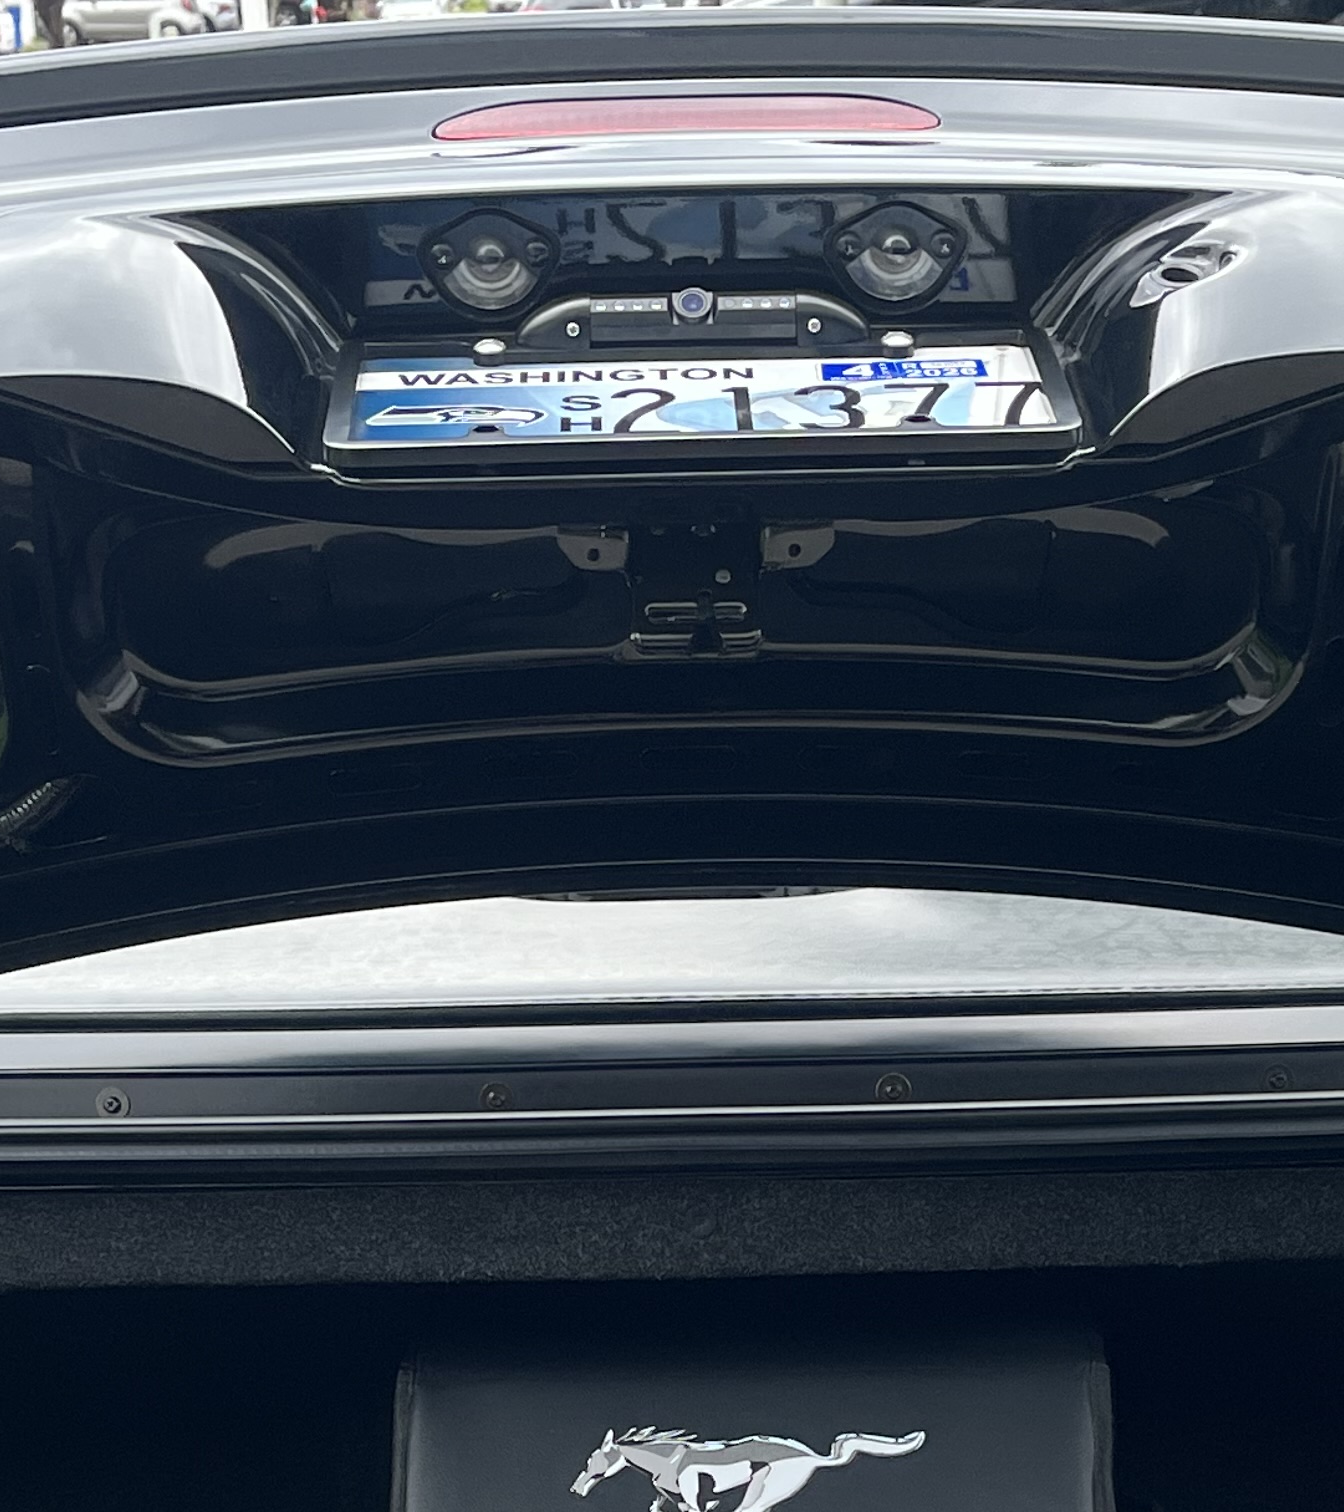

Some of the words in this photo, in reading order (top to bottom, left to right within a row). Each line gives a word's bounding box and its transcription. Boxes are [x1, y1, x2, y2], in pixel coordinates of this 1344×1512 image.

[398, 367, 754, 386] WASHINGTON
[842, 364, 874, 378] 4
[906, 368, 979, 378] 2026
